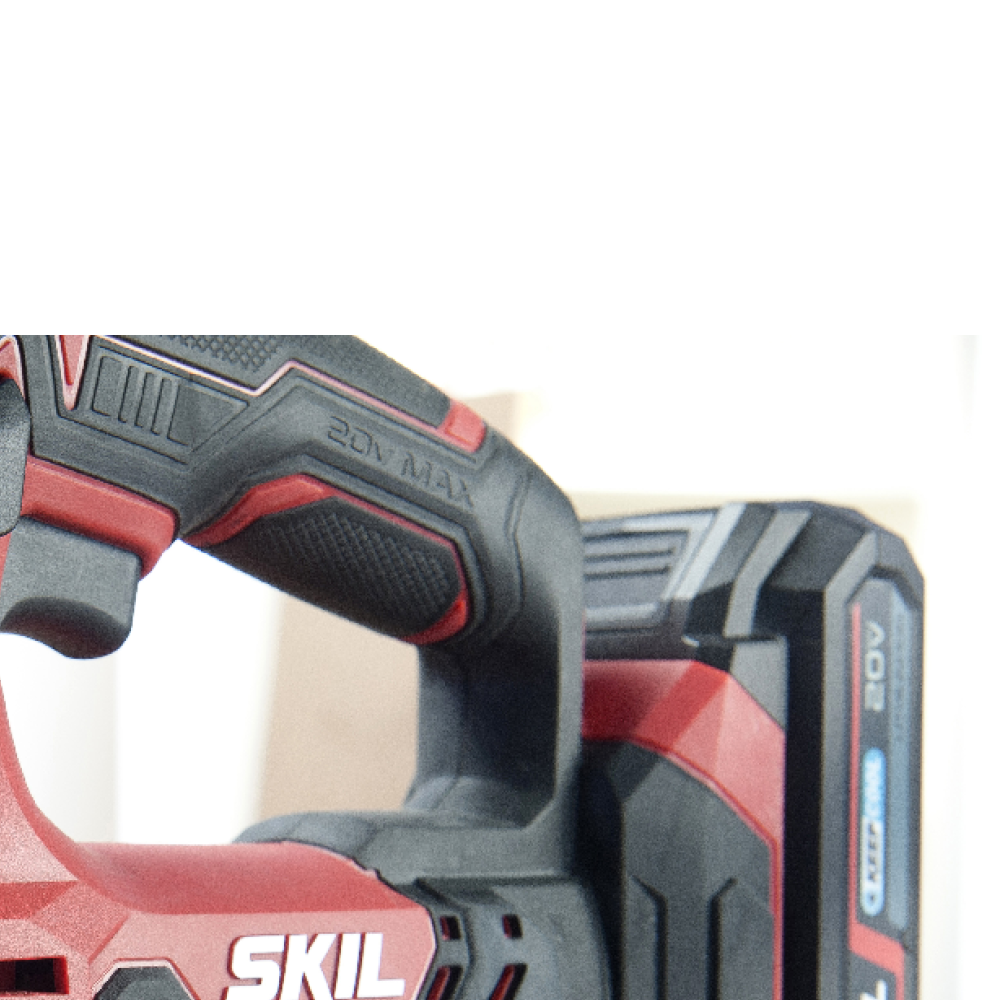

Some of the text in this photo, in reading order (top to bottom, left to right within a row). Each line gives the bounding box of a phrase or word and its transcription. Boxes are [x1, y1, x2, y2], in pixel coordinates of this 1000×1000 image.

[328, 415, 475, 509] 20V MAX
[864, 620, 885, 712] 20V
